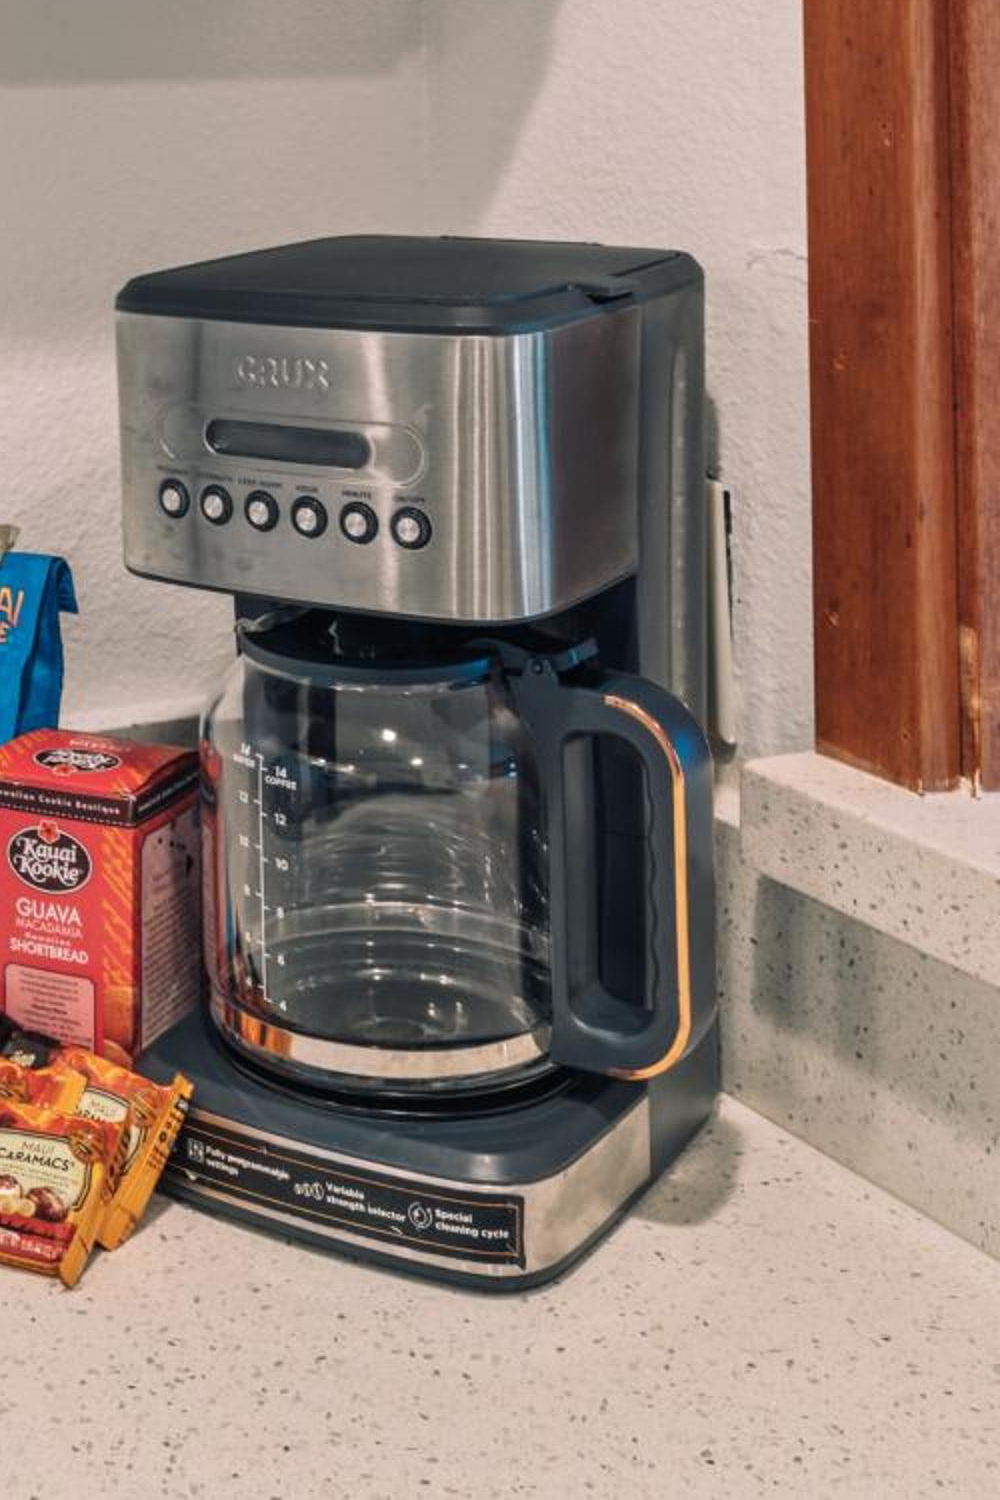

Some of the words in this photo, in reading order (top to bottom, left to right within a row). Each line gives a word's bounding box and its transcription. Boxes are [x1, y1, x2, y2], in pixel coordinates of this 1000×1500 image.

[275, 765, 287, 778] 14
[264, 775, 297, 791] COFFEE
[38, 793, 72, 808] Cookie
[75, 800, 121, 816] Boutique
[274, 812, 287, 827] 12
[16, 836, 77, 862] Kauai
[13, 854, 80, 886] Kookie
[275, 857, 289, 871] 10
[16, 897, 83, 928] GUAVA
[9, 937, 89, 965] SHORTBREAD
[22, 1141, 55, 1156] MAUI
[325, 1181, 365, 1200] Variable
[326, 1195, 366, 1213] strength
[434, 1208, 472, 1223] Special
[434, 1221, 479, 1239] cleaning
[480, 1229, 510, 1240] cycle
